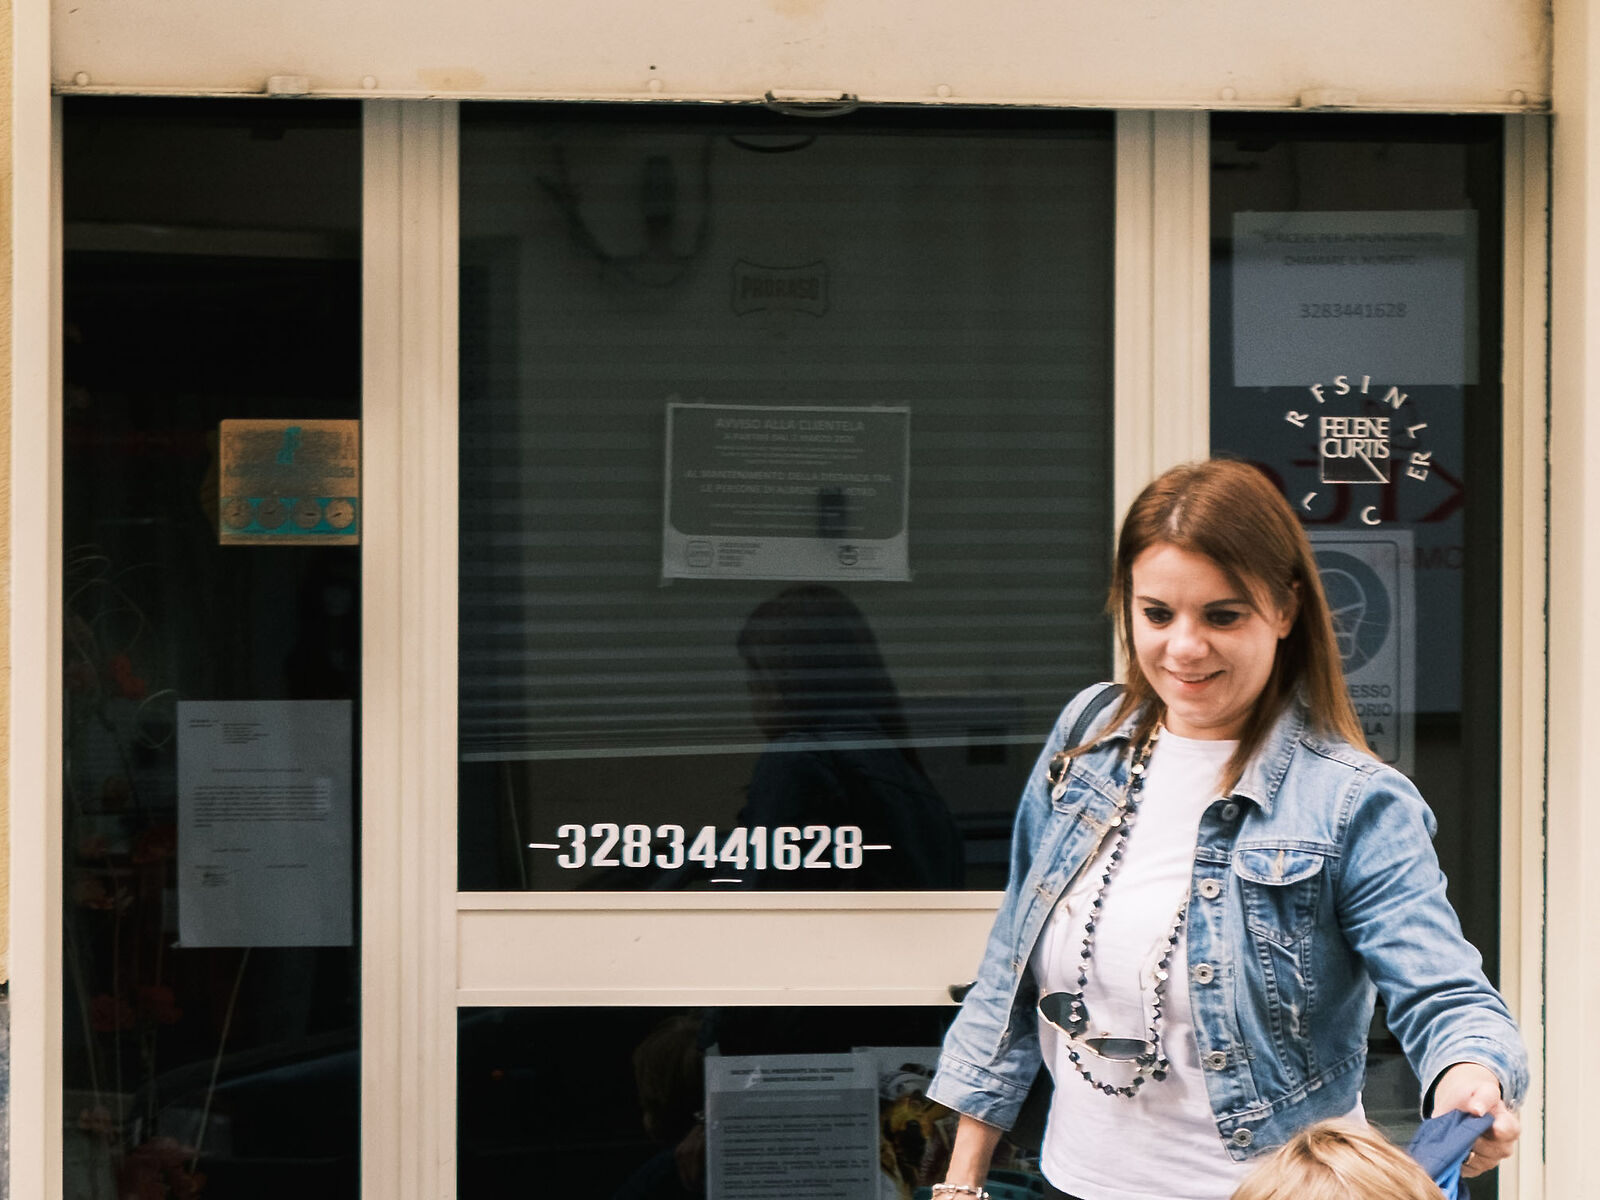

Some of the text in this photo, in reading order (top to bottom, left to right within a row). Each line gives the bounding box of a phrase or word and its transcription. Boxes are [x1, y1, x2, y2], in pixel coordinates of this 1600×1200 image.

[1300, 302, 1408, 318] 3283441628
[1320, 438, 1391, 460] CURTIS
[1351, 684, 1392, 698] ESSO
